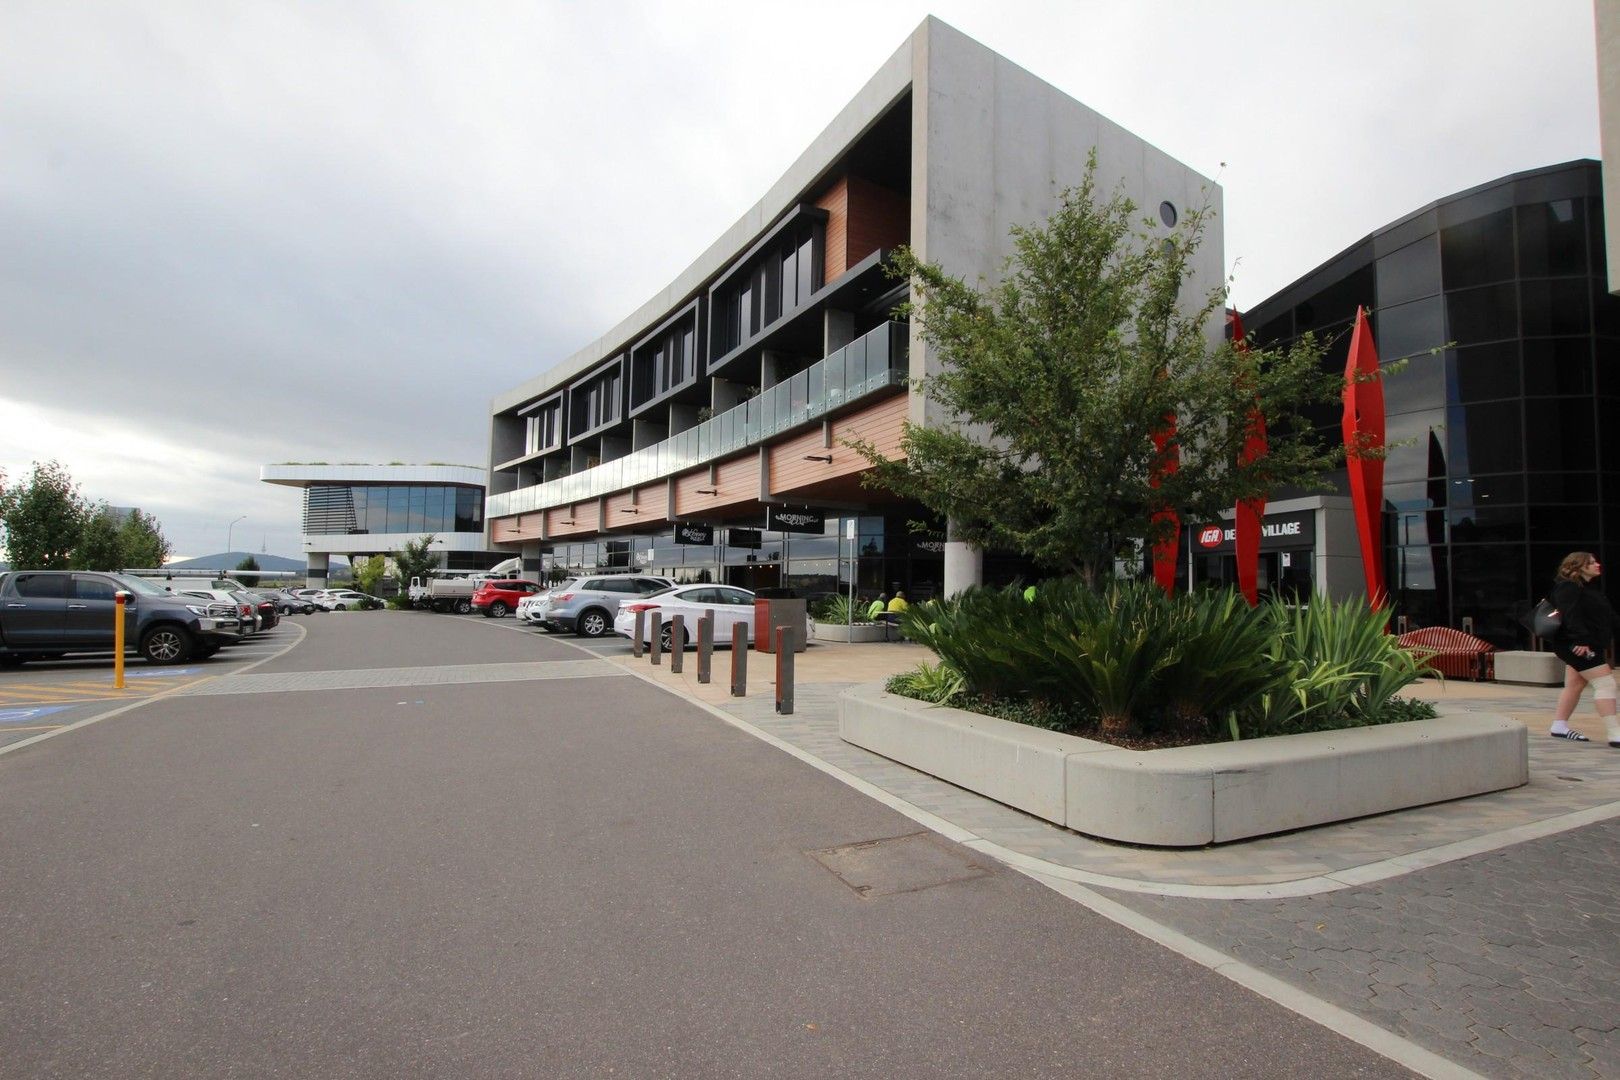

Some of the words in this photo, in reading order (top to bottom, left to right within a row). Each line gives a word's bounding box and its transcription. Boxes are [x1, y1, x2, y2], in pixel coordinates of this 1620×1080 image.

[780, 513, 814, 522] MORNING
[1201, 530, 1220, 543] IGA
[1261, 522, 1300, 537] VILLAGE
[921, 541, 945, 550] MORN
